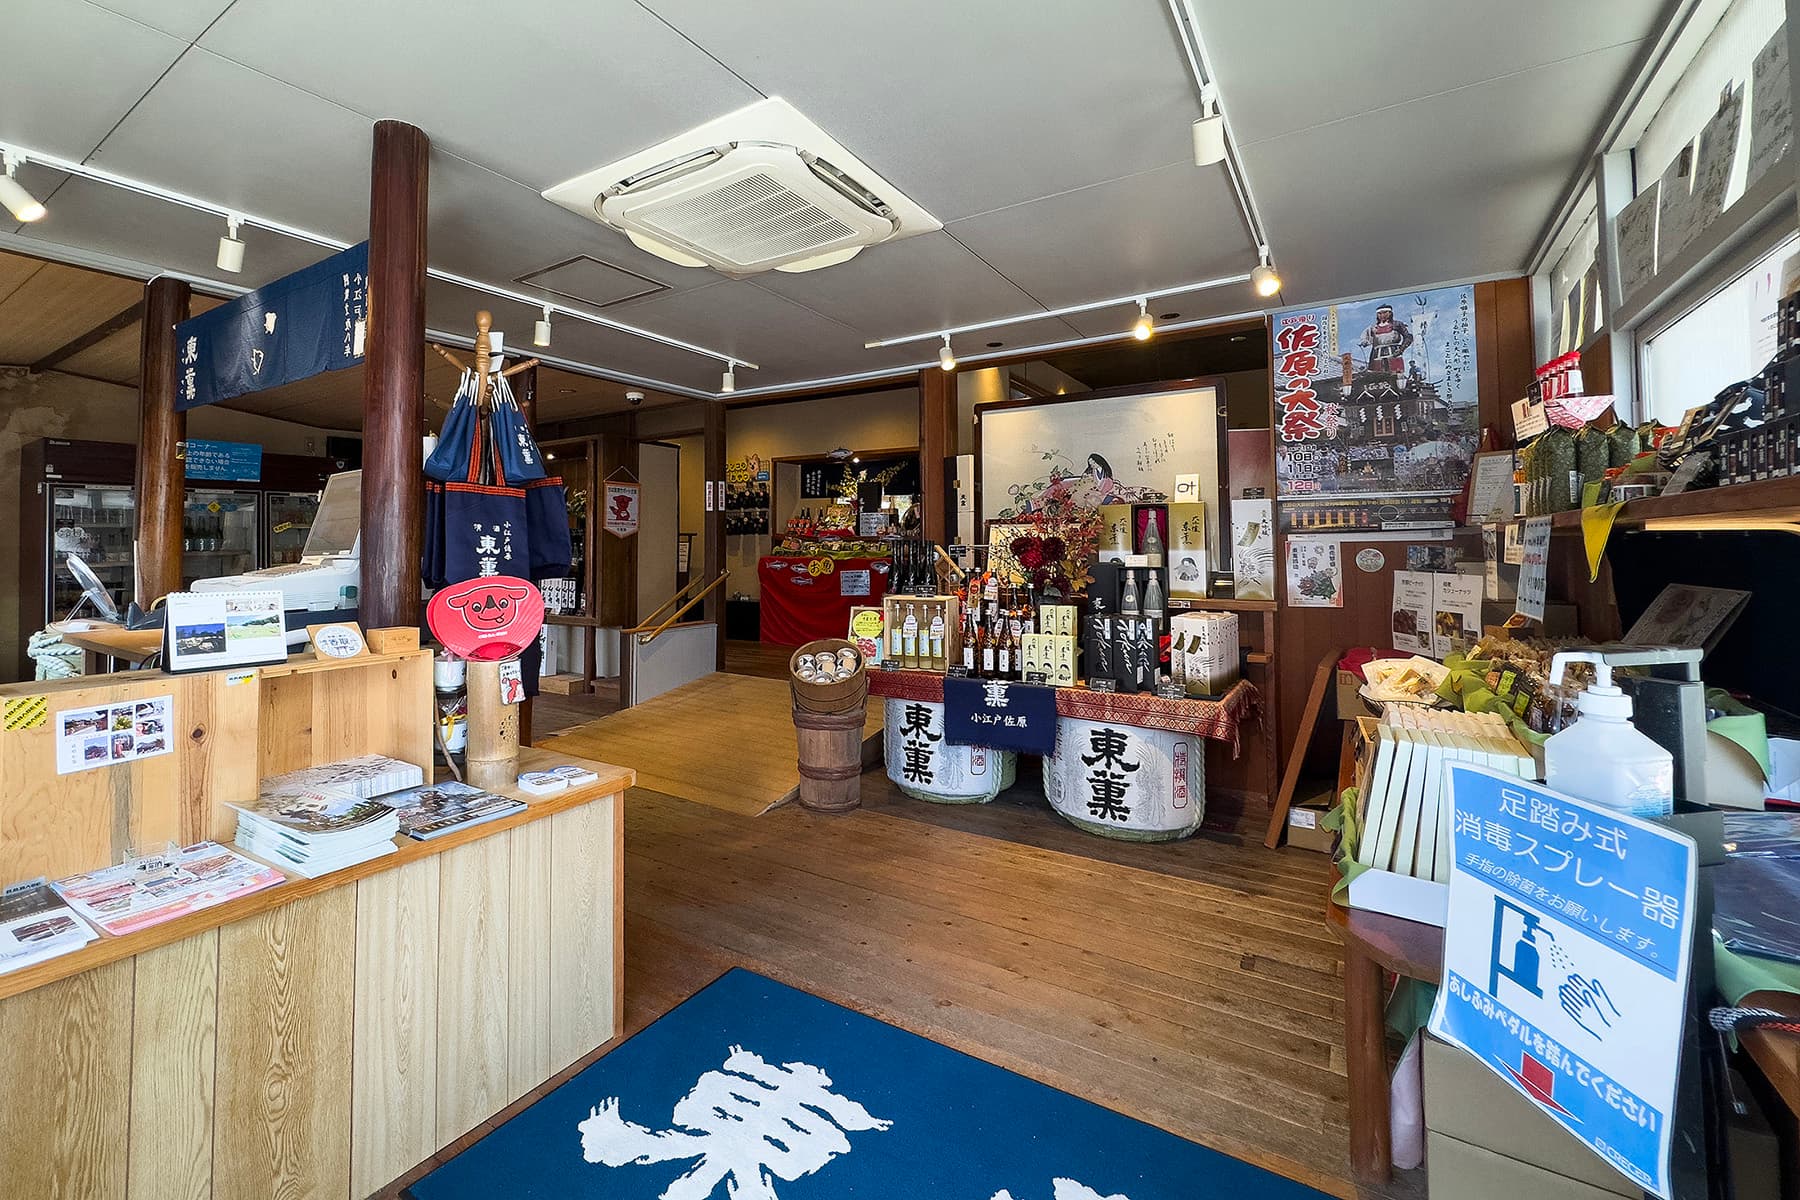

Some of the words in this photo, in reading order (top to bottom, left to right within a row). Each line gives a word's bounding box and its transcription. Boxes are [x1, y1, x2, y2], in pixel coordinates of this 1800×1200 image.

[1277, 323, 1325, 442] 佐原の大祭
[1324, 402, 1339, 440] 秋祭り
[475, 535, 501, 577] 東薫
[503, 521, 512, 561] 小江戸佐原
[971, 713, 1028, 728] 小江戸佐原
[983, 680, 1010, 707] 薫
[900, 703, 942, 785] 東薫
[1081, 728, 1140, 822] 東薫
[1500, 788, 1629, 860] 足踏み式
[1455, 808, 1680, 930] 消毒スプレー器
[1464, 853, 1659, 959] 手指の除菌をお願いします。
[1449, 975, 1656, 1132] あしふみペダルを踏んでください
